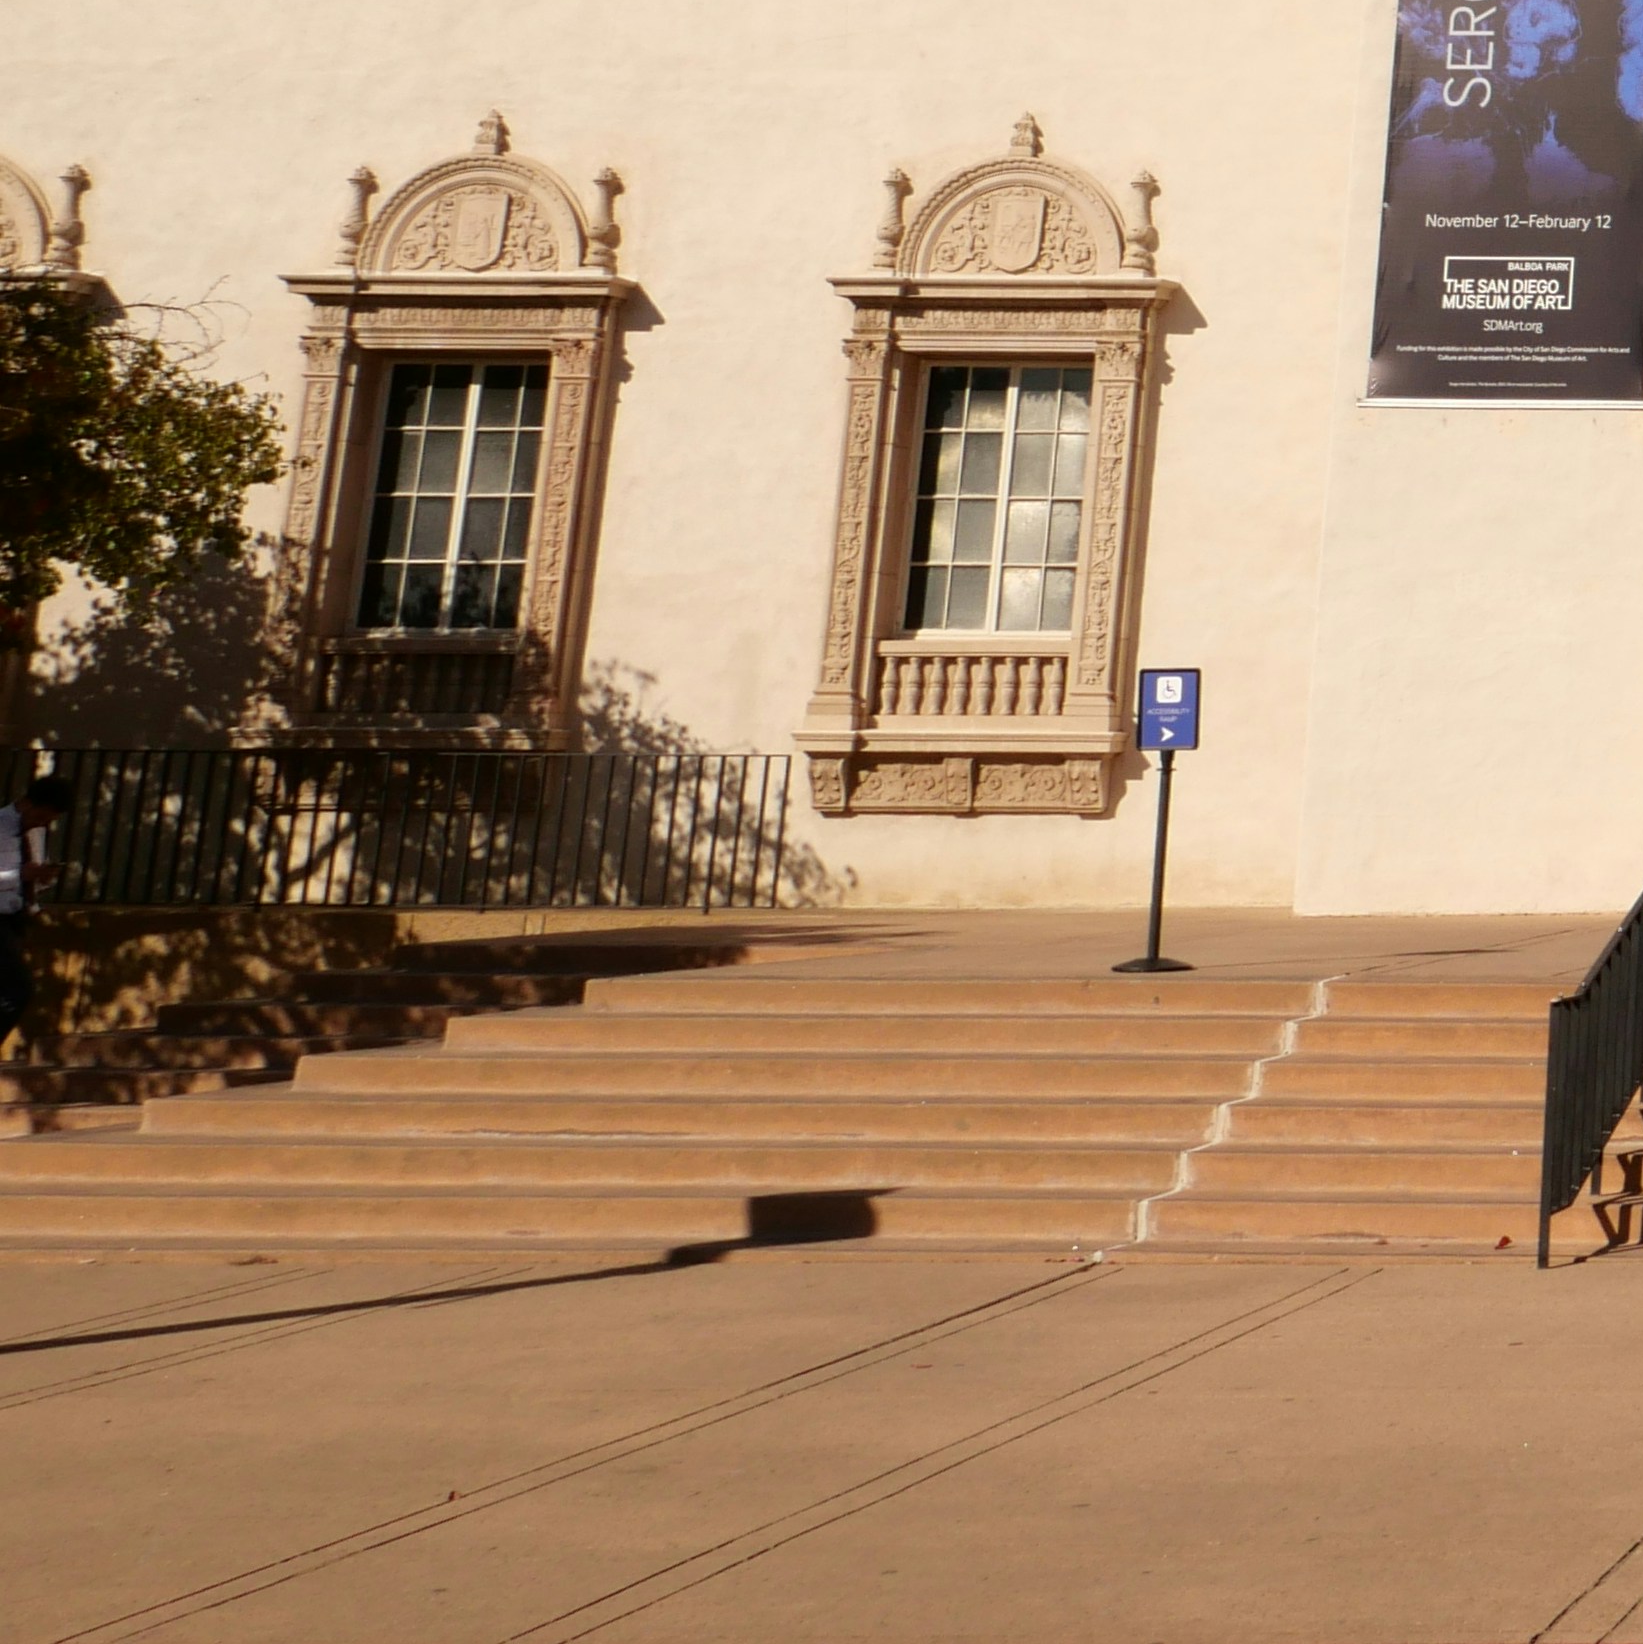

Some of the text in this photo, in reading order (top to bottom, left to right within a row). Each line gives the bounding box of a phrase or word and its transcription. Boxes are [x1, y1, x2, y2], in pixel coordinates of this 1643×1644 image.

[1425, 214, 1499, 229] November
[1595, 215, 1612, 229] 12
[1508, 262, 1569, 272] BALBOA PARK
[1445, 279, 1560, 295] THE SAN DIEGO
[1442, 294, 1566, 310] MUSEUM OF ART
[1483, 319, 1544, 334] SDMArt.org
